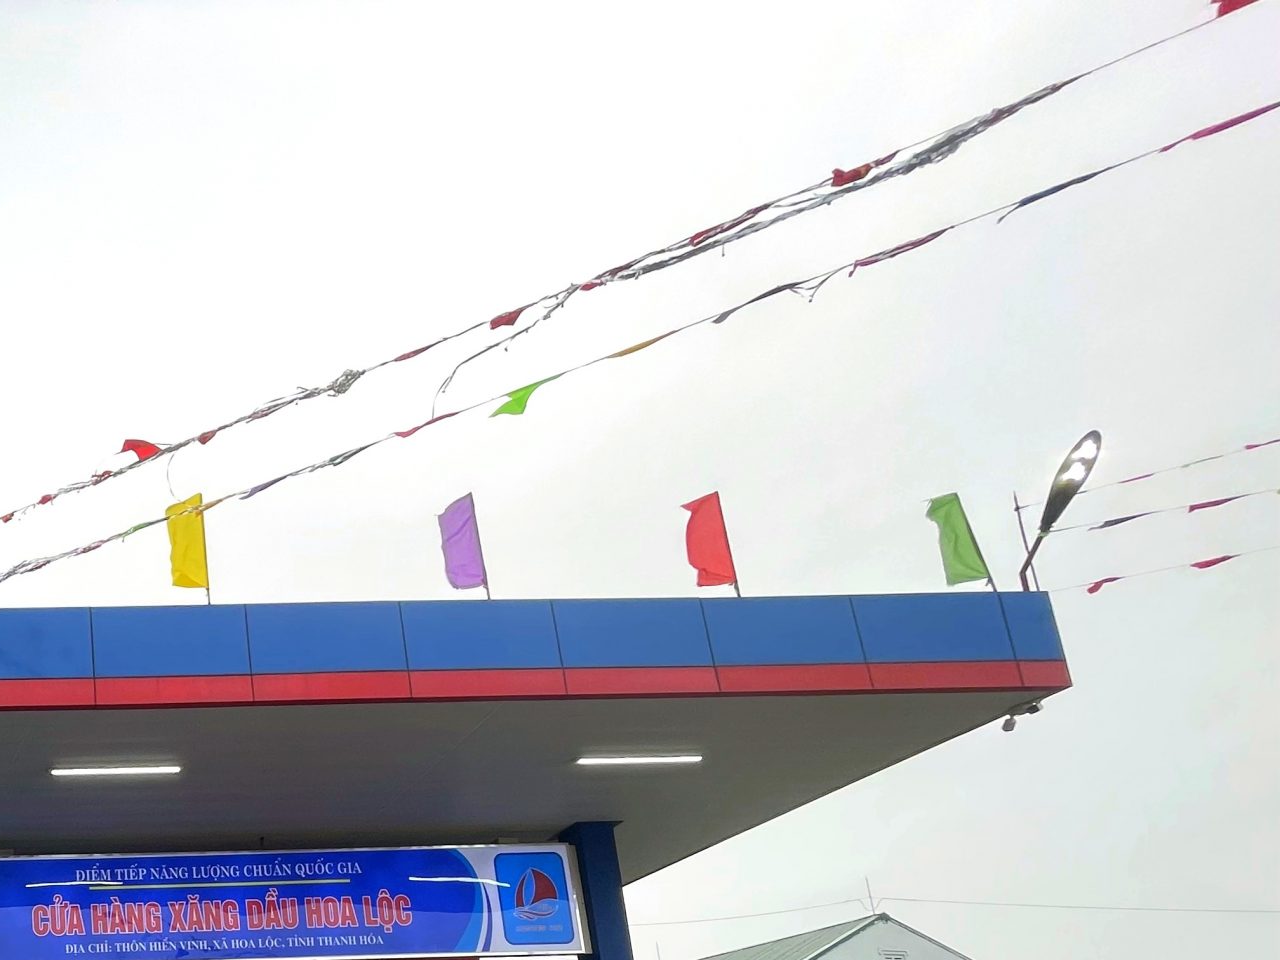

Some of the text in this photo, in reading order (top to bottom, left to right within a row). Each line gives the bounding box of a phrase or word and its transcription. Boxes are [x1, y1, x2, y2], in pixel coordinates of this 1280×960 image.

[75, 858, 363, 881] ĐIỂM TIẾP NĂNG LƯỢNG CHUẨN QUỐC GIA
[32, 888, 412, 936] CỬA HÀNG XĂNG DẦU HOA LỘC
[66, 943, 85, 954] ĐỊA
[115, 940, 147, 952] THÔN
[213, 938, 228, 949] XÃ
[231, 938, 256, 949] HOA
[317, 935, 356, 947] THANH
[359, 932, 384, 945] HÓA
